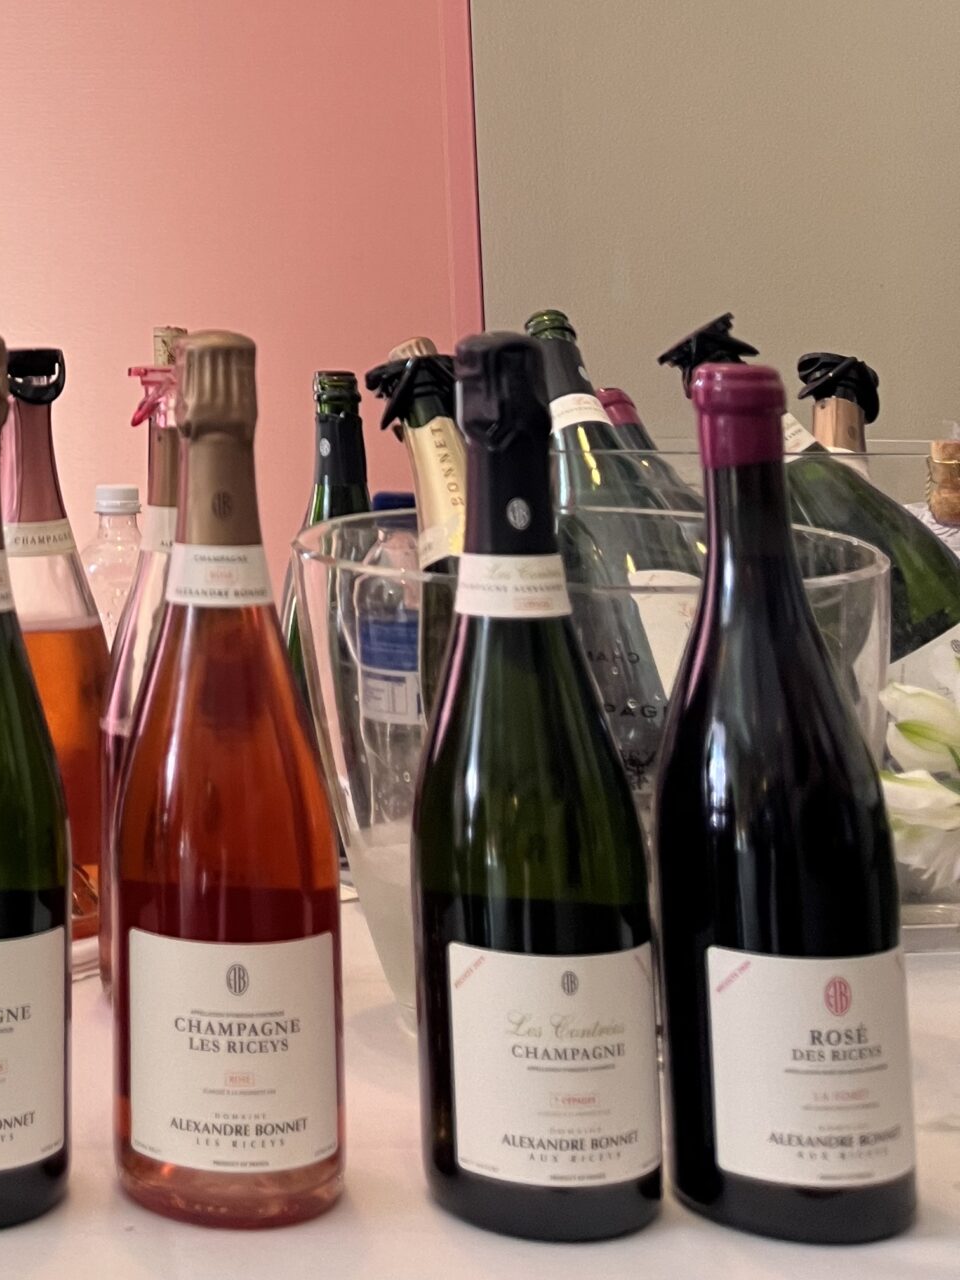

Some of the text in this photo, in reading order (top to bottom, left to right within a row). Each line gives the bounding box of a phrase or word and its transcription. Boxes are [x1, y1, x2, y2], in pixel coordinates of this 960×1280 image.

[174, 1017, 301, 1037] CHAMPAGNE
[809, 1022, 869, 1047] ROSÉ
[188, 1037, 289, 1055] LES RICEYS
[511, 1043, 626, 1062] CHAMPAGNE
[792, 1048, 826, 1062] DES
[169, 1117, 308, 1137] ALEXANDRE BONNET
[232, 1138, 286, 1149] RICEYS
[502, 1130, 639, 1151] ALEXANDRE BONNET
[767, 1131, 855, 1148] ALEXANDRE
